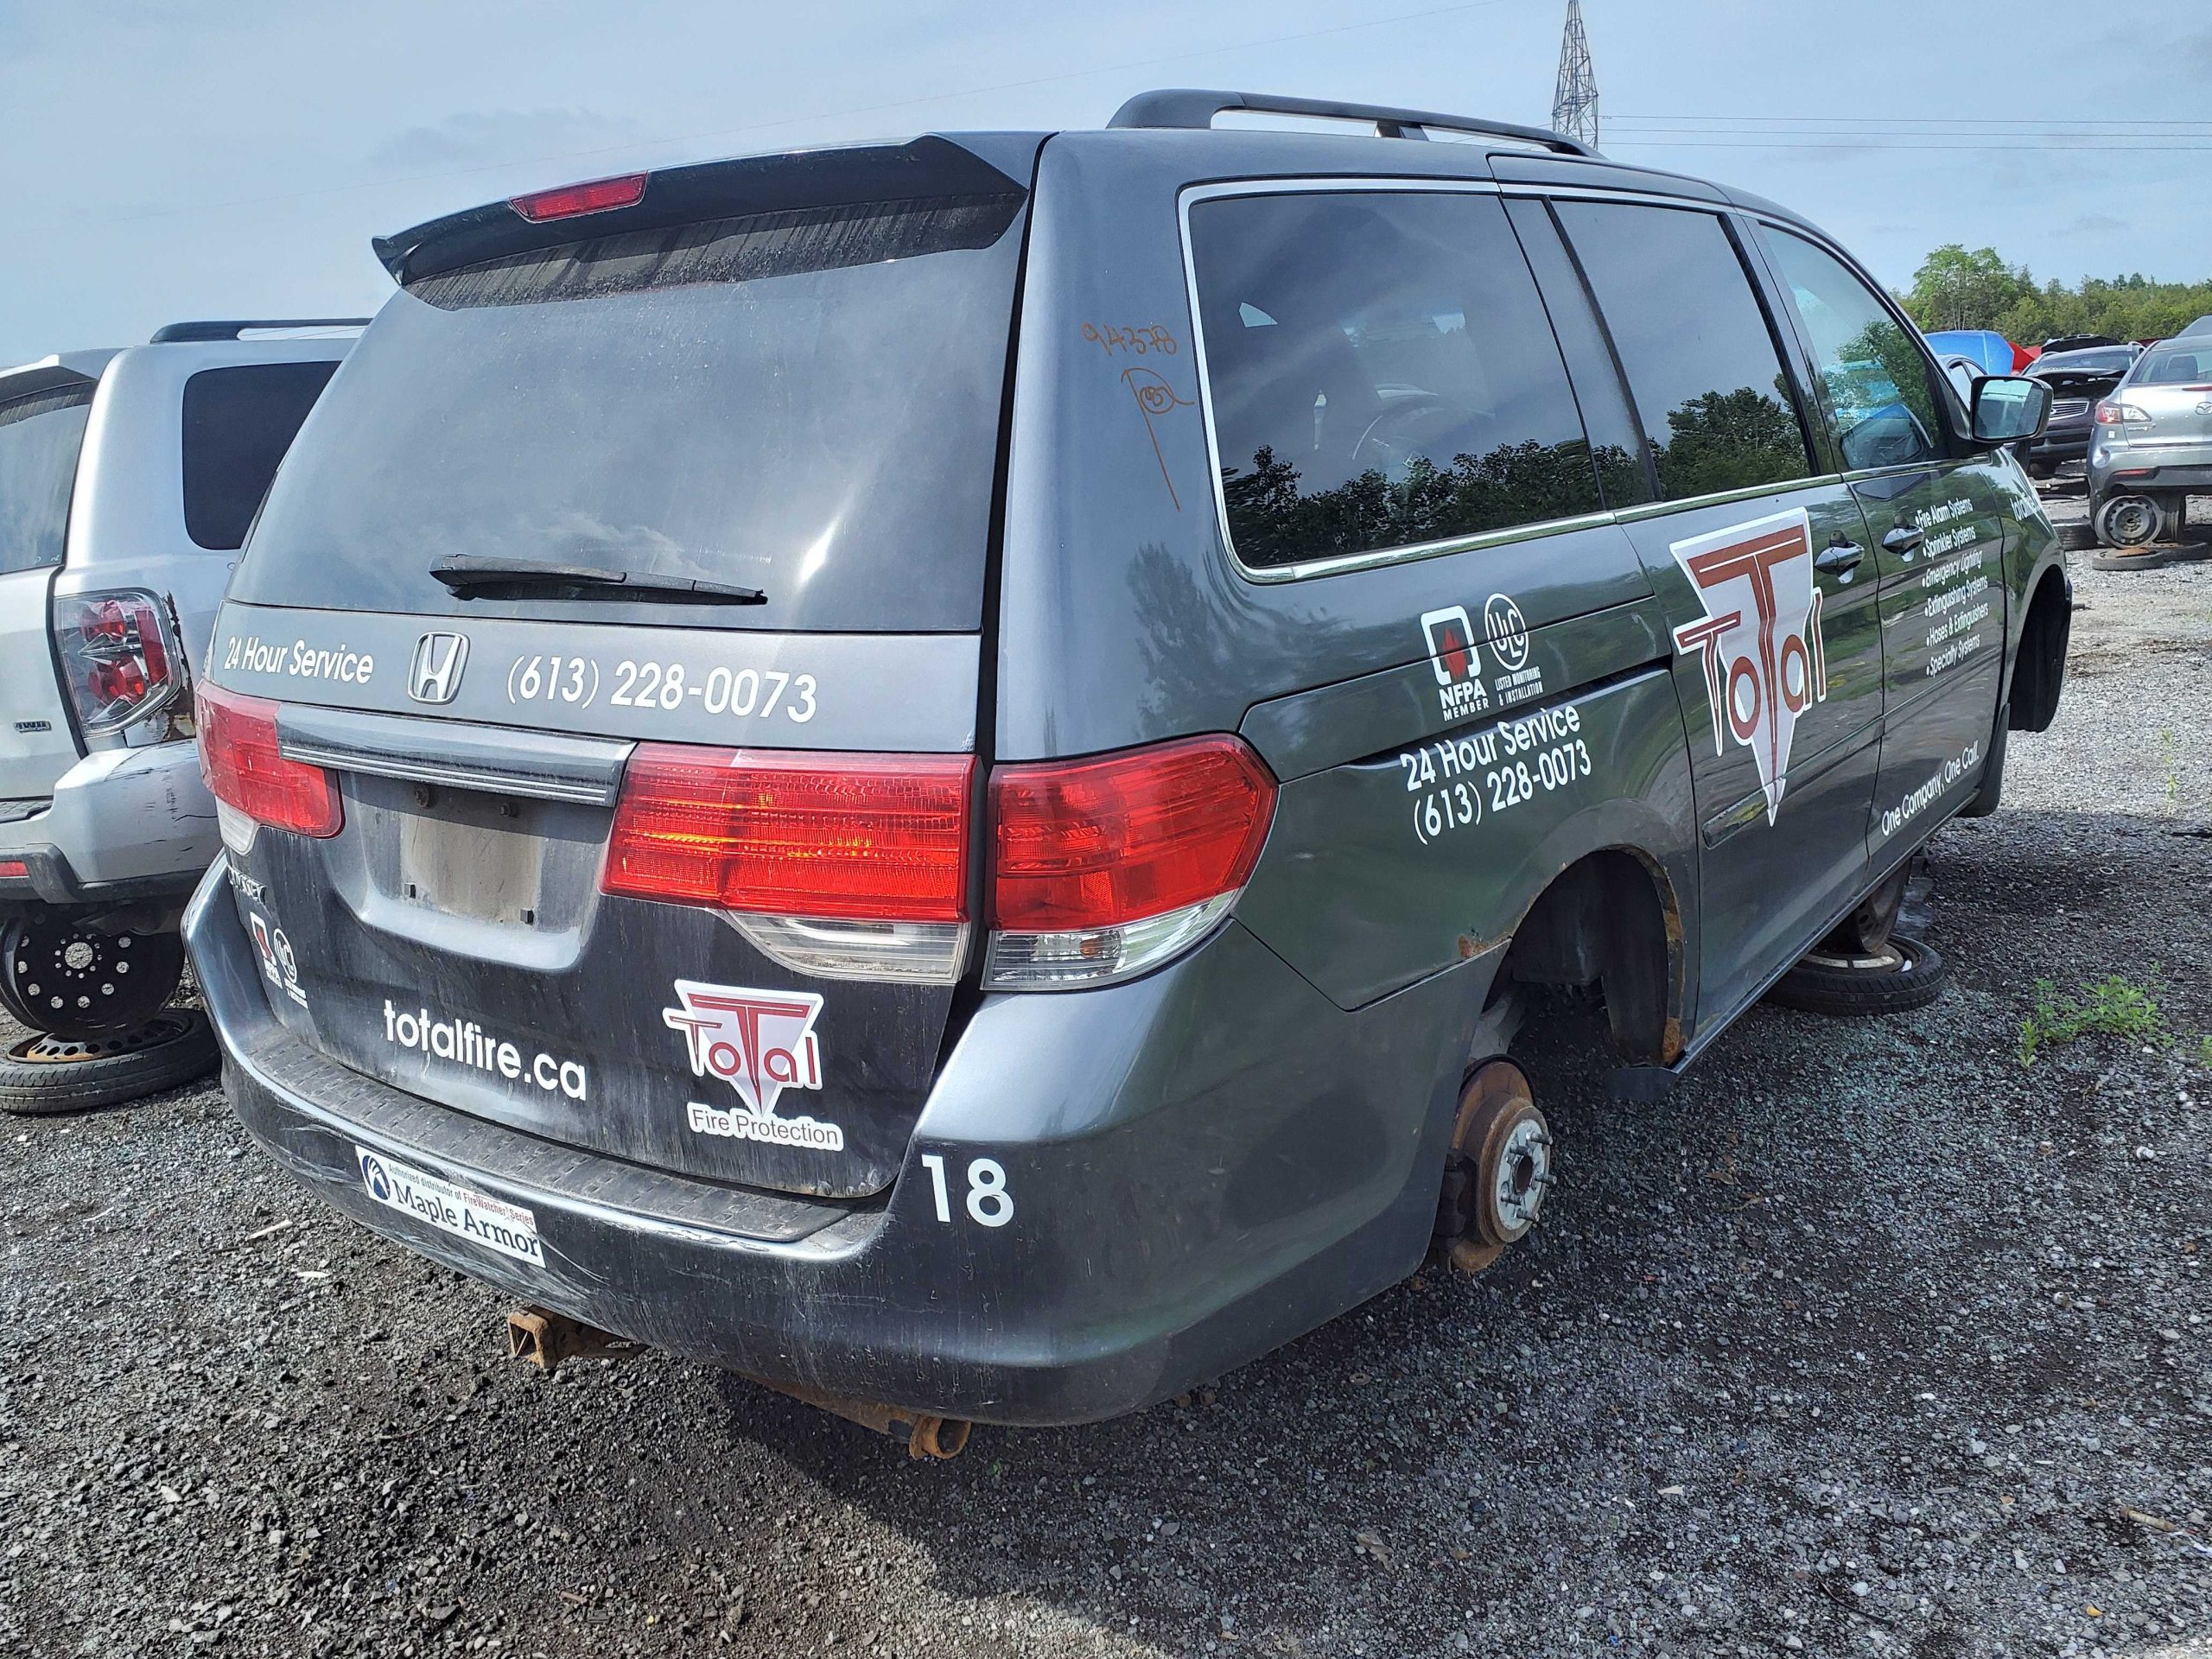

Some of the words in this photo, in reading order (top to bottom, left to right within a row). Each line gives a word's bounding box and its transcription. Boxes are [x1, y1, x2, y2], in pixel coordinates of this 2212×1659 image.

[1917, 509, 1932, 528] Fire
[1930, 505, 1952, 524] Alarm
[1948, 498, 1974, 520] Systems
[1925, 532, 1953, 561] Sprinkler
[1952, 525, 1976, 550] Systems
[1926, 560, 1961, 588] Emergency
[1961, 549, 1982, 575] Lighting
[1928, 584, 1966, 617] Extinguishing
[1967, 575, 1987, 601] Systems
[1929, 624, 1948, 647] Hoses
[1955, 602, 1988, 632] Extinguishers
[224, 636, 242, 670] 24
[241, 637, 289, 673] Hour
[289, 639, 374, 684] Service
[1930, 645, 1958, 678] Specialty
[1958, 633, 1980, 661] Systems
[507, 655, 601, 709] (613)
[610, 659, 817, 723] 228-0073
[1439, 678, 1487, 709] NFPA
[1495, 675, 1512, 691] LISTED
[1512, 666, 1541, 685] MONITORING
[1505, 681, 1543, 704] INSTALLATION
[1442, 697, 1490, 721] MEMBER
[1400, 748, 1436, 791] 24
[1435, 732, 1497, 778] Hour
[1497, 705, 1580, 755] Service
[1414, 781, 1482, 845] (613)
[1487, 739, 1592, 812] 228-0073
[1882, 807, 1901, 836] One
[1902, 772, 1945, 819] Company,
[1945, 758, 1961, 784] One
[383, 999, 587, 1102] totalfire.ca
[691, 1109, 730, 1132] Fire
[735, 1114, 839, 1146] Protection
[389, 1165, 420, 1185] Authorized
[421, 1178, 453, 1198] distributor
[454, 1191, 461, 1200] of
[509, 1209, 534, 1226] Series
[921, 1154, 1014, 1228] 18
[391, 1179, 458, 1227] Maple
[463, 1208, 538, 1257] Armor
